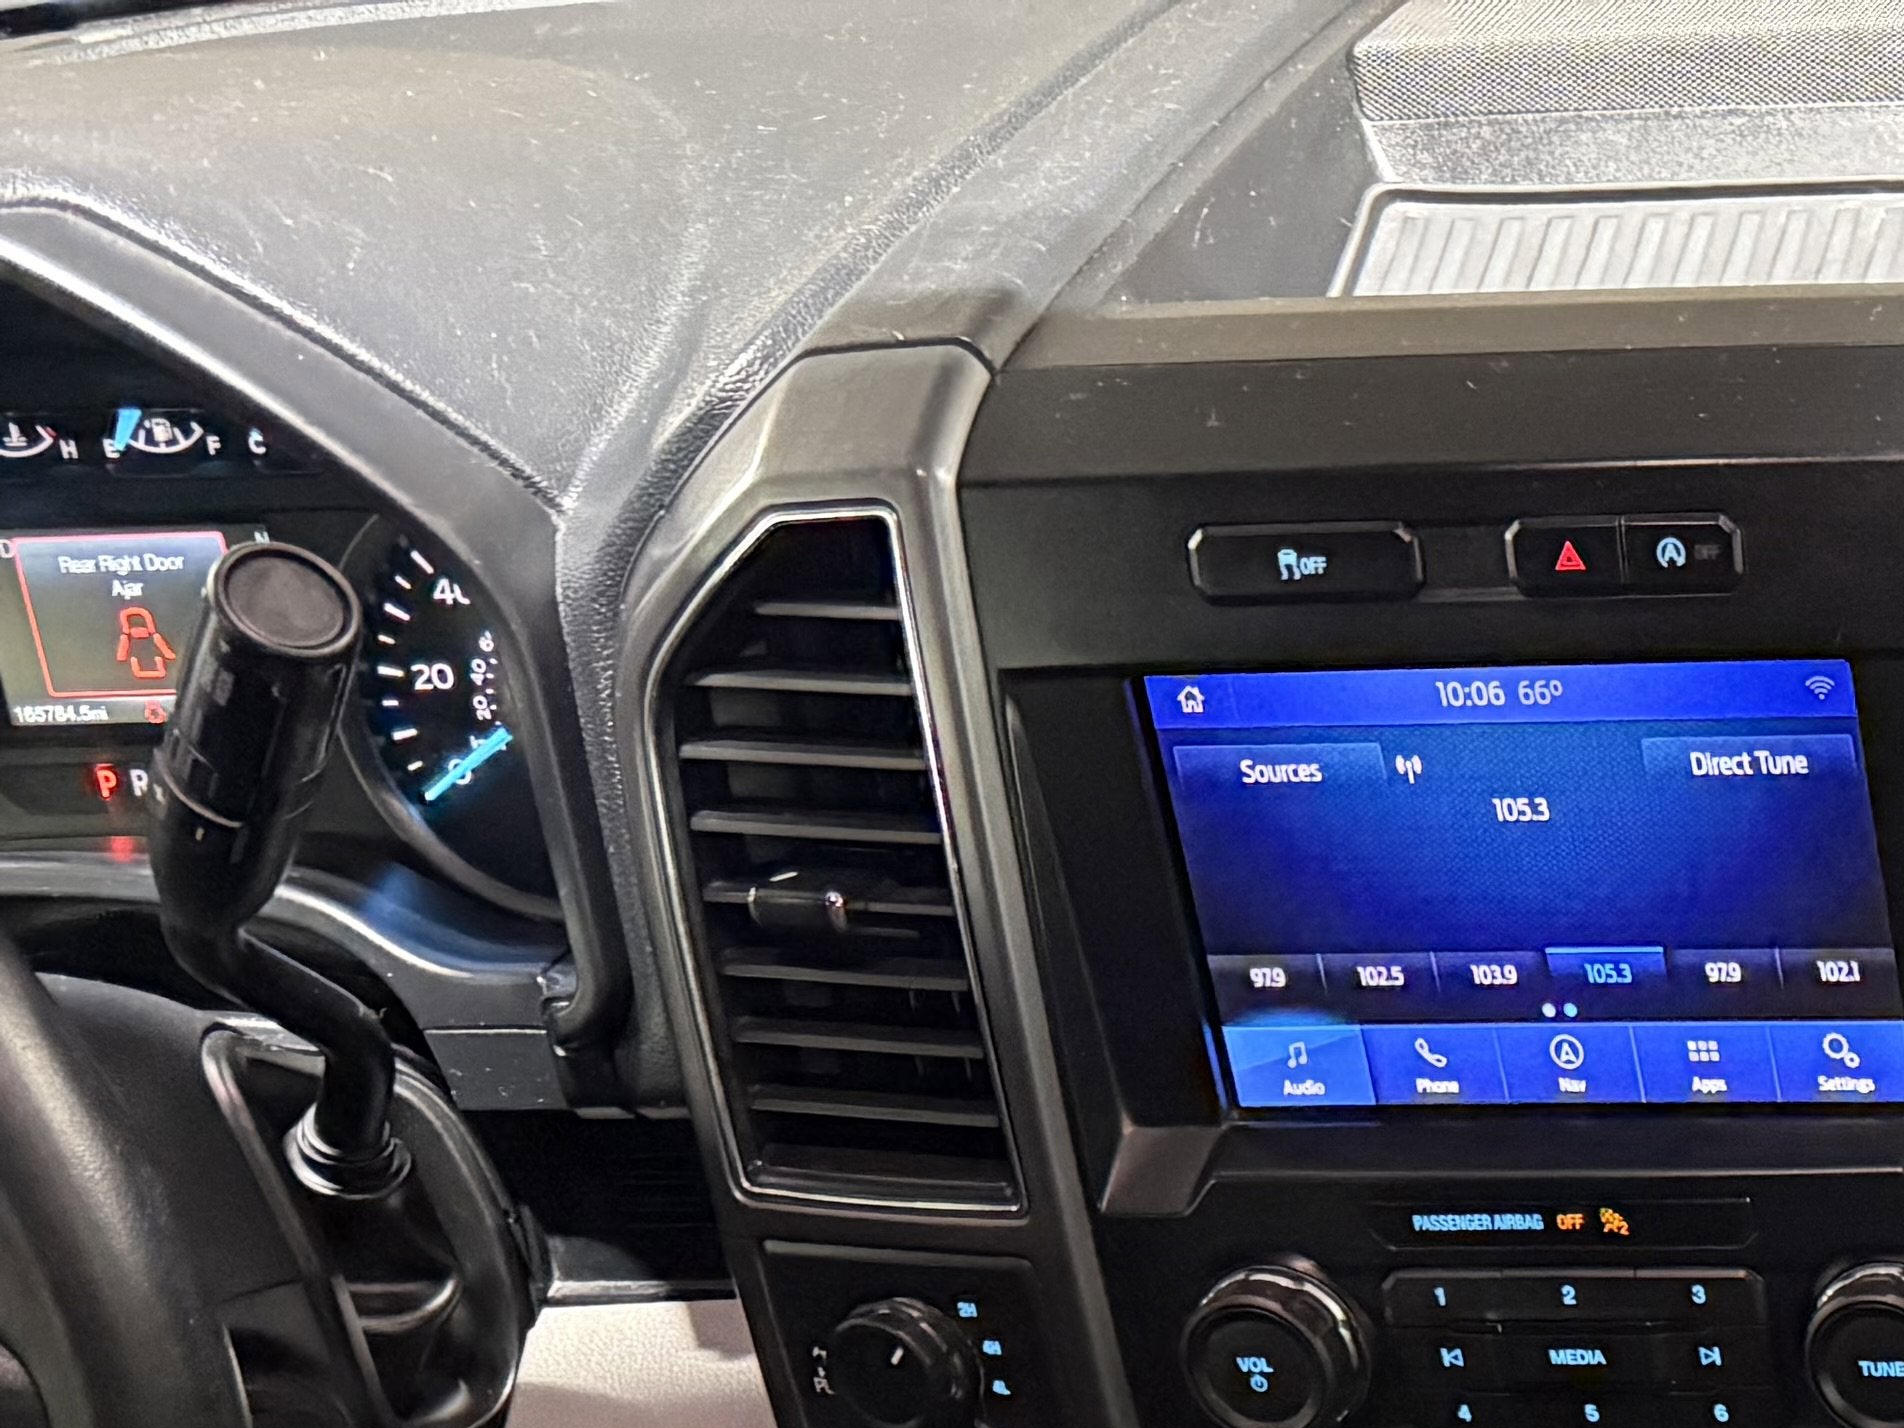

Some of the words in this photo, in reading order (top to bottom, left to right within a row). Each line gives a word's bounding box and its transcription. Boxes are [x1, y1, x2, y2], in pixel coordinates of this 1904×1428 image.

[60, 439, 79, 459] H
[58, 556, 96, 574] Rear
[98, 553, 143, 576] Right
[143, 553, 185, 572] Door
[1300, 555, 1328, 576] OFF
[112, 579, 144, 600] Ajar
[410, 662, 455, 690] 20
[1435, 680, 1506, 707] 10:06
[1240, 758, 1323, 785] Sources
[1689, 752, 1753, 776] Direct
[1753, 749, 1809, 775] Tune
[96, 767, 118, 798] P
[1491, 796, 1550, 823] 105.3
[1356, 965, 1405, 987] 102.5
[1470, 964, 1518, 986] 103.9
[1584, 963, 1633, 984] 105.3
[1816, 960, 1861, 982] 102.1
[1283, 1079, 1327, 1096] Audio
[1416, 1077, 1460, 1094] Phone
[1558, 1076, 1587, 1093] Nav
[1691, 1076, 1728, 1094] Apps
[1817, 1075, 1876, 1094] Settings
[1412, 1213, 1493, 1232] PASSENGER
[1493, 1213, 1545, 1231] AIRBAG
[1556, 1213, 1585, 1231] OFF
[1433, 1287, 1447, 1306] 1
[1561, 1285, 1577, 1305] 2
[1691, 1284, 1707, 1304] 3
[1236, 1356, 1275, 1373] VOL
[1548, 1349, 1607, 1366] MEDIA
[1457, 1404, 1473, 1423] 4
[1584, 1404, 1600, 1423] 5
[1713, 1404, 1729, 1423] 6
